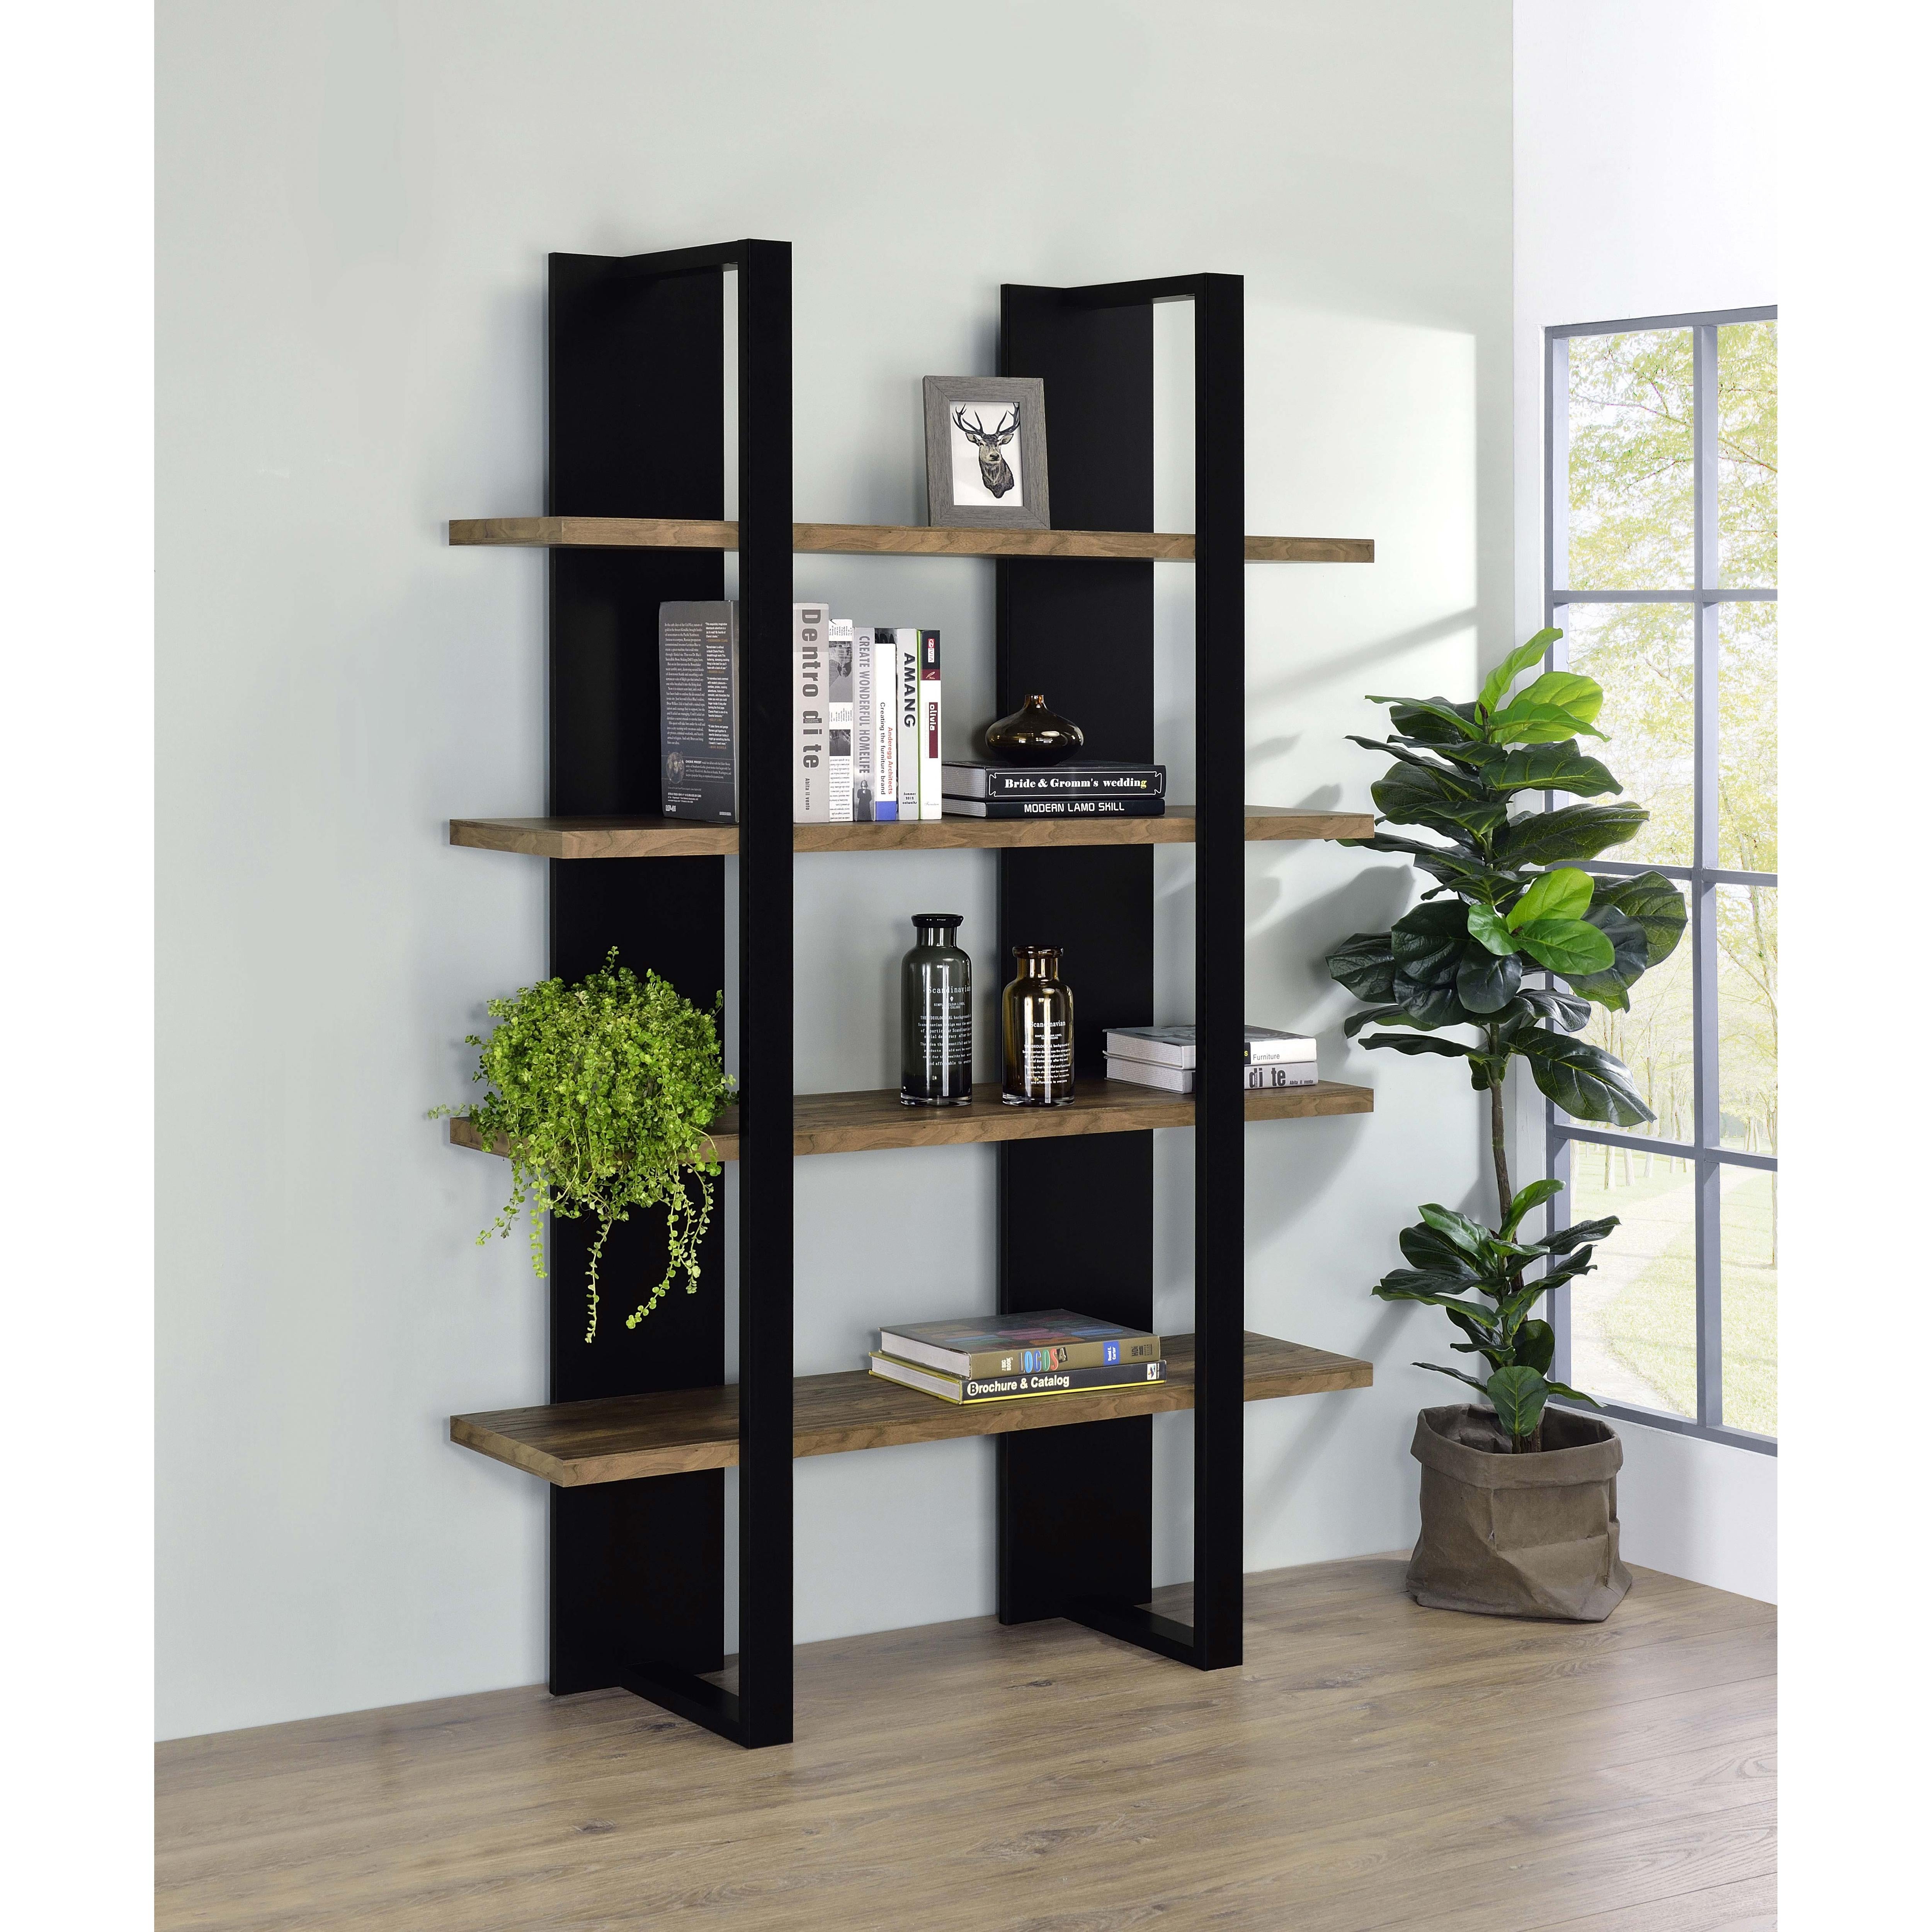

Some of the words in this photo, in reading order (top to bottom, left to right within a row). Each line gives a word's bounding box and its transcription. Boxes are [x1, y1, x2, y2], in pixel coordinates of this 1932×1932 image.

[802, 609, 821, 697] Dentro
[859, 636, 870, 667] CREATE
[859, 671, 870, 726] WONDERFUL
[904, 652, 916, 728] AMANG
[803, 711, 822, 735] di
[803, 744, 821, 768] te
[859, 730, 870, 773] HOMELIFE
[1005, 779, 1036, 788] Bride
[1037, 779, 1048, 788] &
[1050, 778, 1099, 787] Gromm's
[1103, 778, 1147, 789] wedding
[1024, 803, 1064, 813] MODERN
[1068, 803, 1095, 812] LAMO
[1098, 802, 1125, 811] SKILL
[1249, 1068, 1263, 1088] di
[1271, 1068, 1286, 1086] te
[967, 1381, 1017, 1396] Brochure
[1020, 1378, 1028, 1389] &
[1031, 1375, 1070, 1388] Catalog
